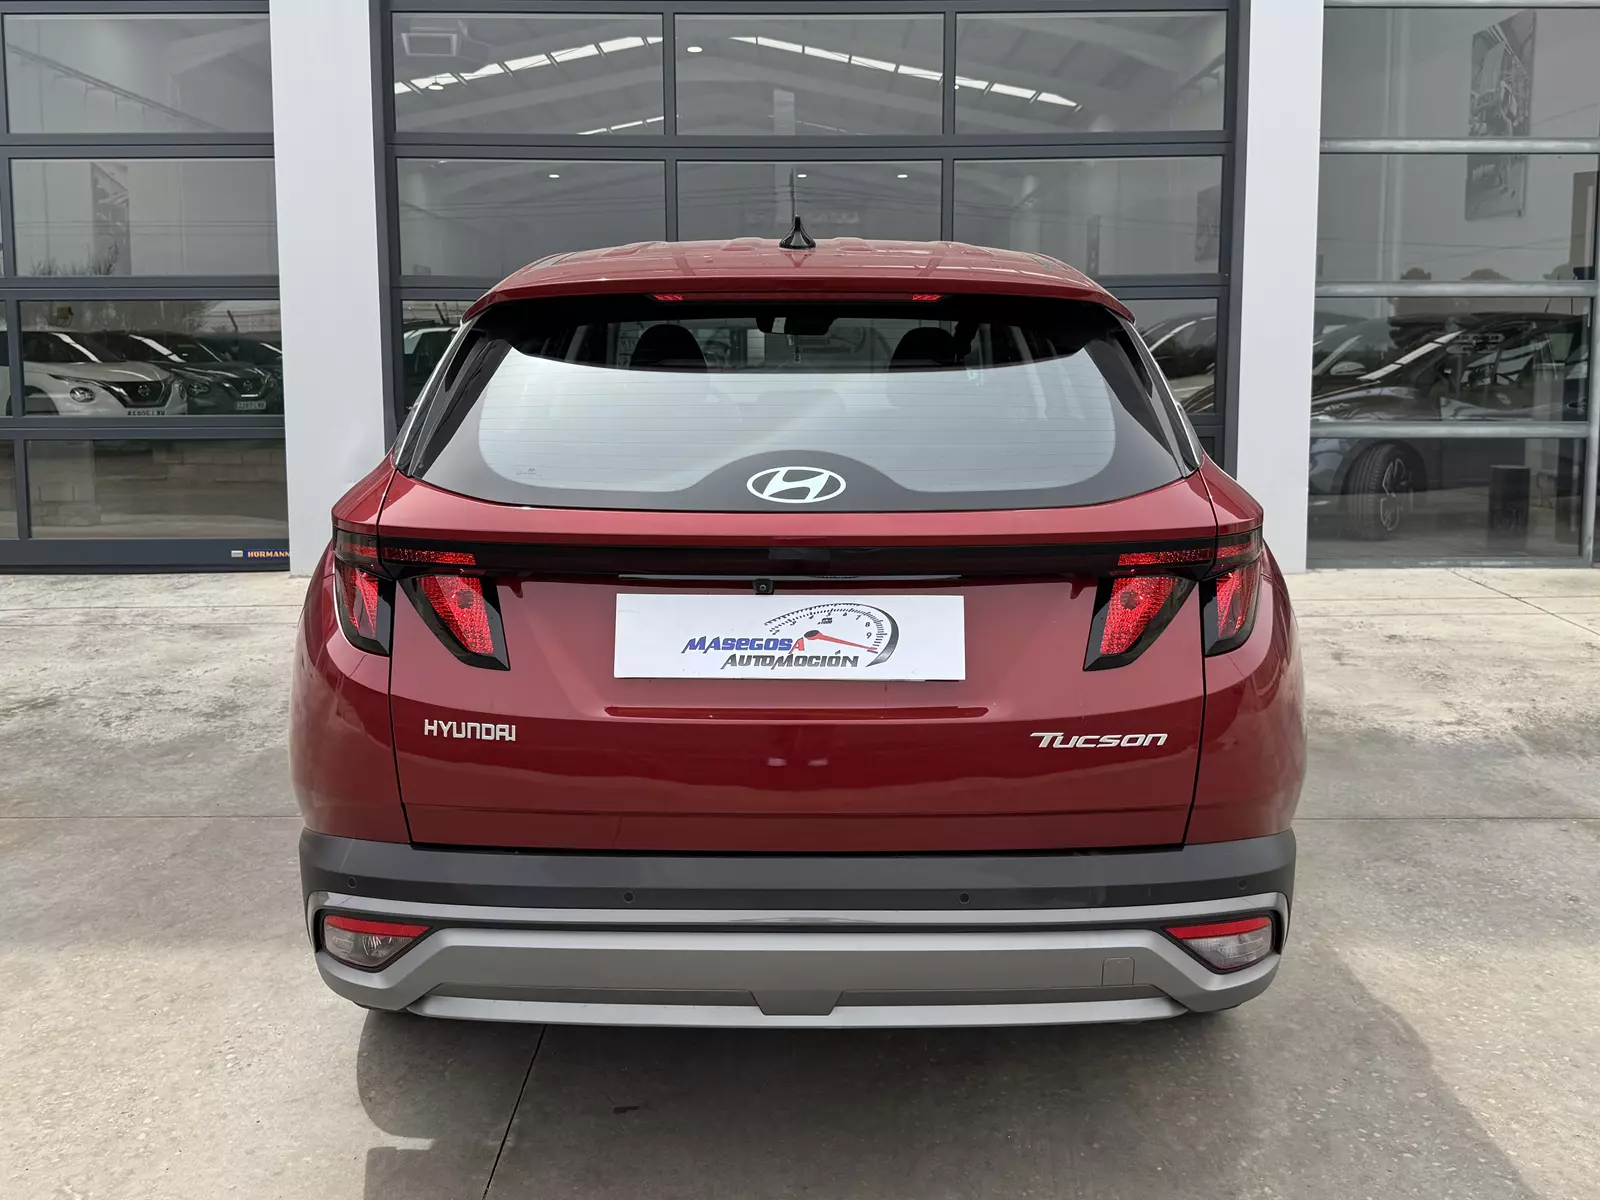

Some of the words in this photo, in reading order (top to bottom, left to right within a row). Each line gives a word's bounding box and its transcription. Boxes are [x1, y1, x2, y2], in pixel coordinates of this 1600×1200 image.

[681, 636, 805, 654] MASEGOSA
[720, 650, 859, 670] AUTOMOCIÓN
[424, 719, 516, 741] HYUNDAI
